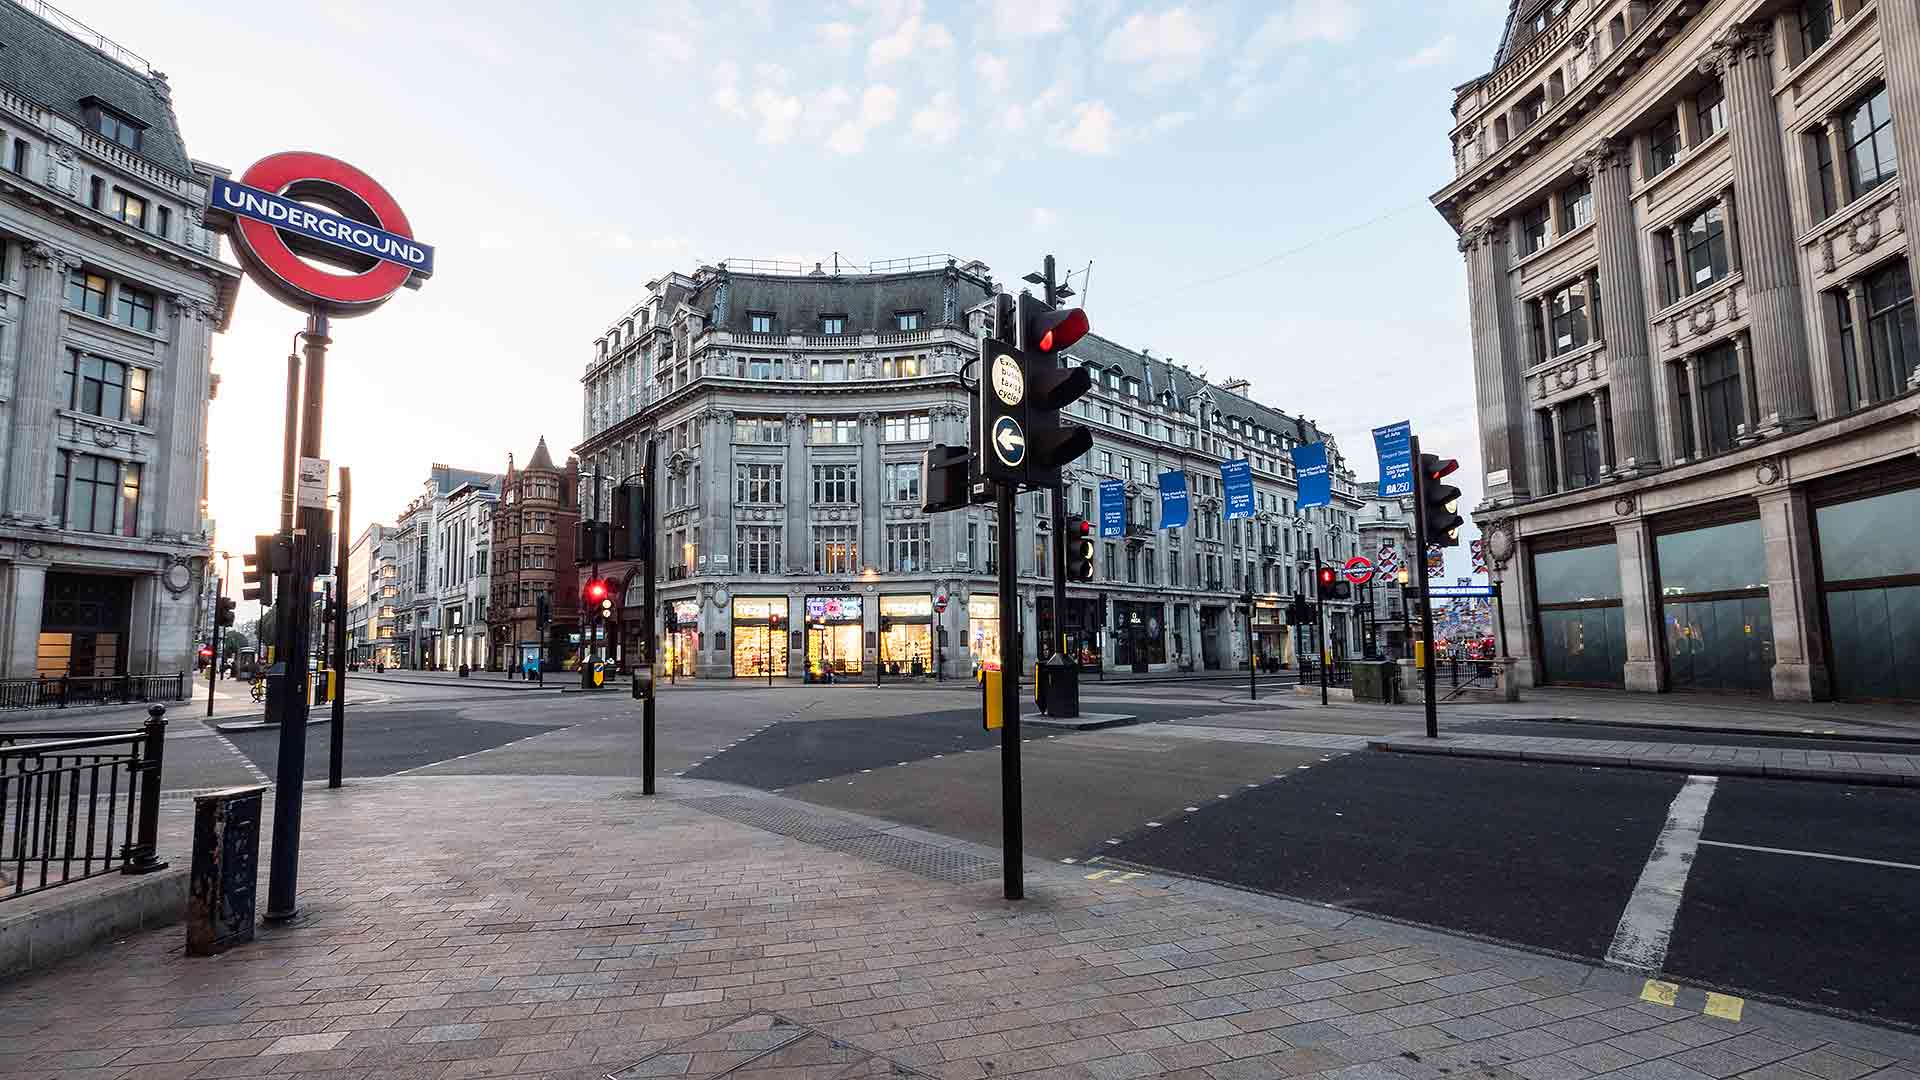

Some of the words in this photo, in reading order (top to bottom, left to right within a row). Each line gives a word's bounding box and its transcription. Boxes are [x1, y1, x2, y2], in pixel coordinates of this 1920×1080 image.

[224, 187, 424, 264] UNDERGROUND
[1386, 481, 1410, 495] RA250
[817, 584, 850, 592] TEZENIS
